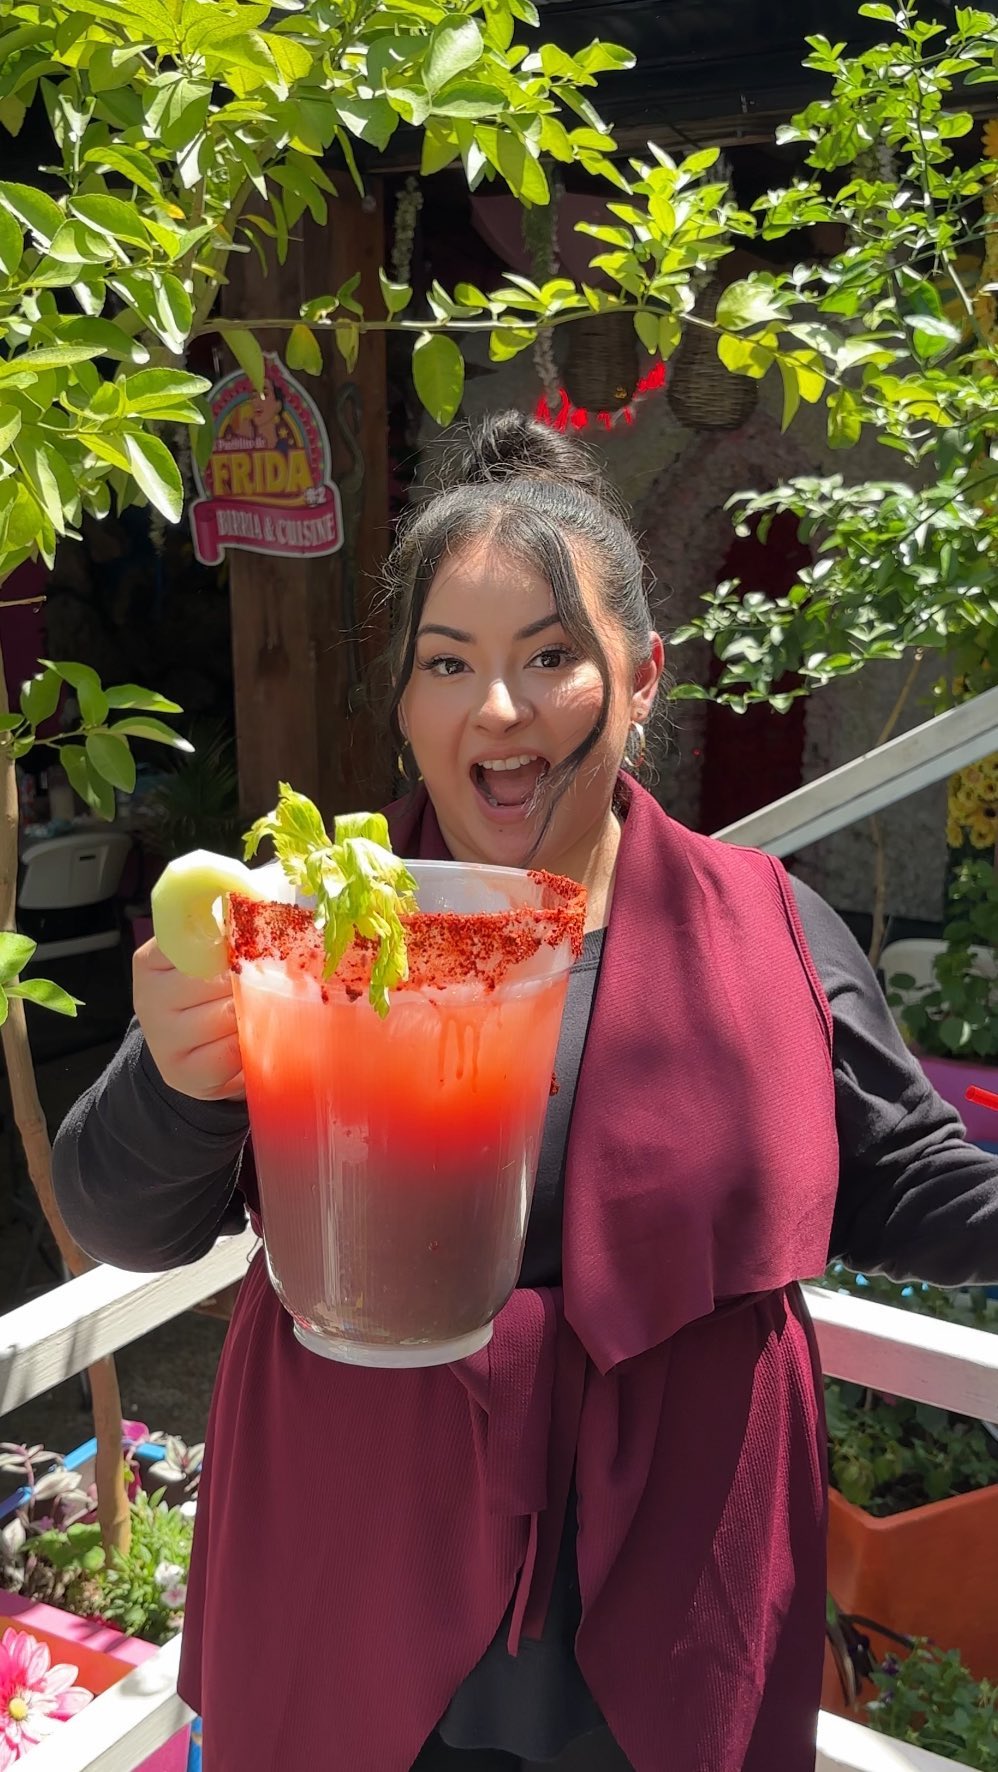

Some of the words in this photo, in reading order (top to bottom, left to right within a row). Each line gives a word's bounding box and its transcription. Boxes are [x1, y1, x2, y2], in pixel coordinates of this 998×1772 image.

[212, 449, 313, 496] FRIDA
[215, 510, 262, 540] BIRRIA
[263, 516, 276, 542] &
[275, 512, 336, 547] CUISINE
